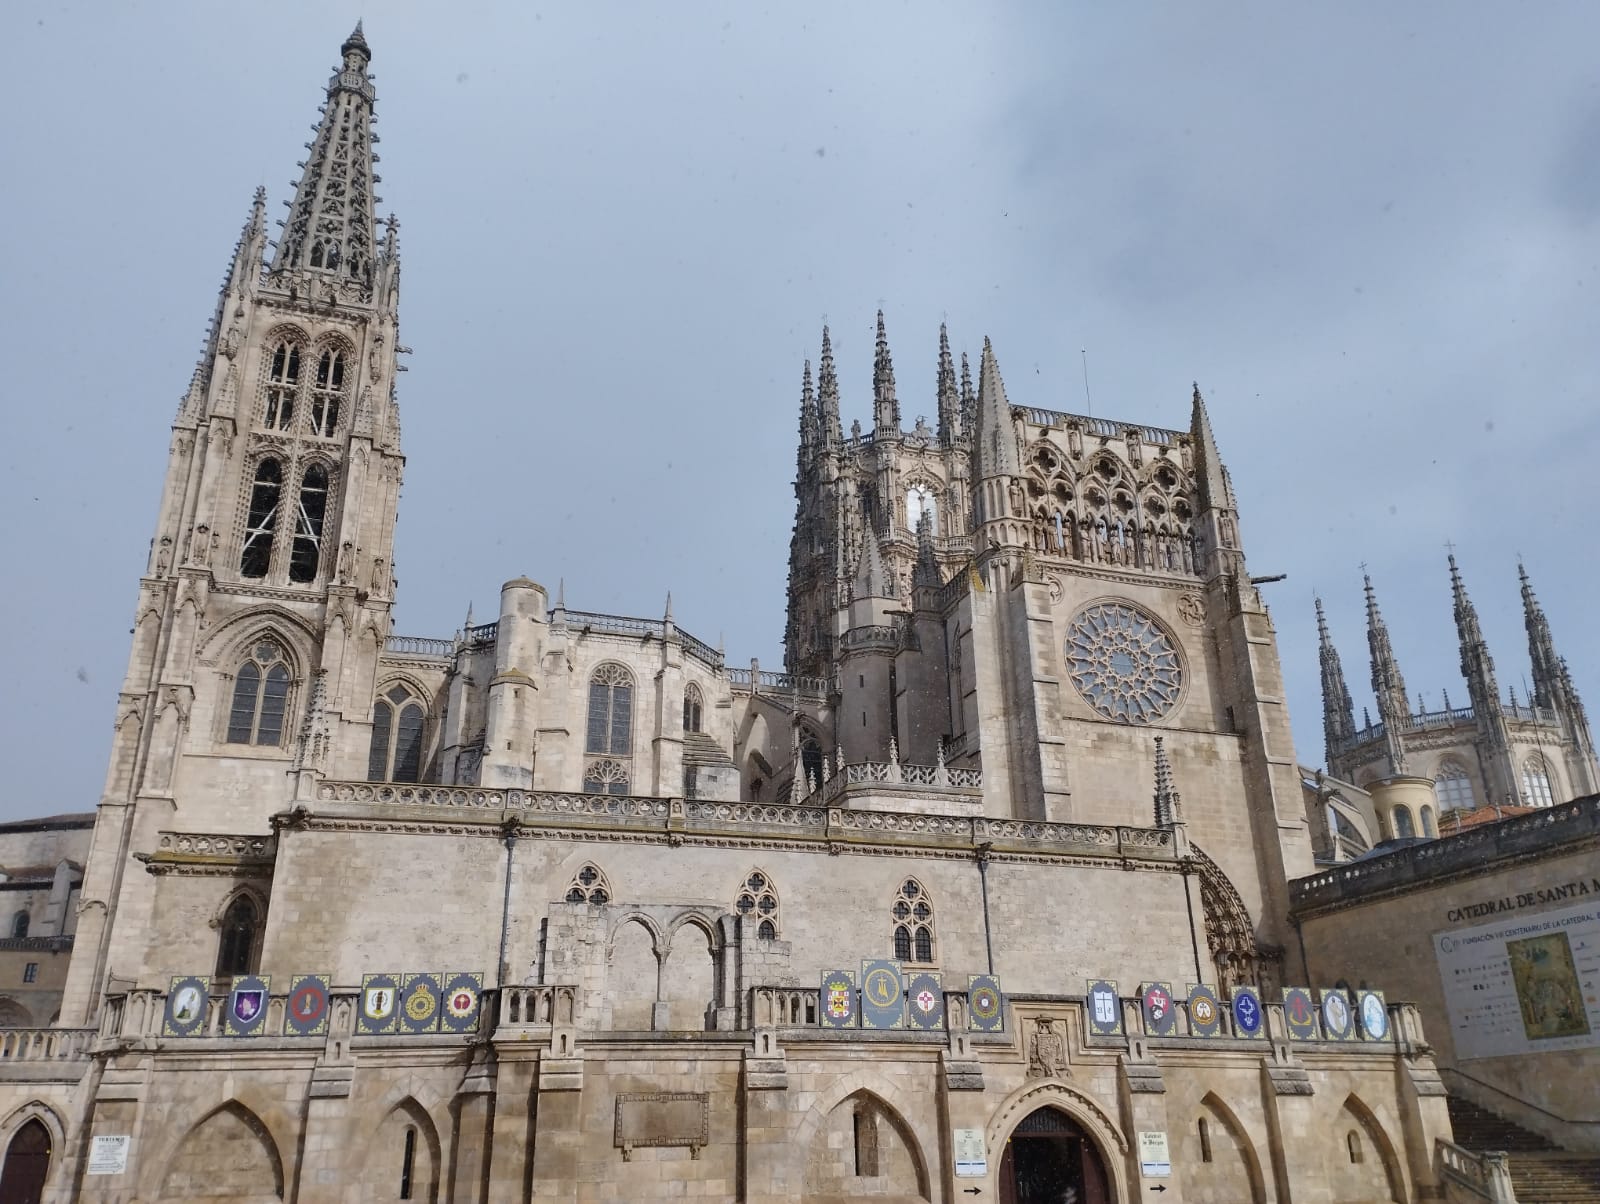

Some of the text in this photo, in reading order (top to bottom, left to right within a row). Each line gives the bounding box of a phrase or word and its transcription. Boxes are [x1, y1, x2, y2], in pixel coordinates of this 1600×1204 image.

[1447, 897, 1516, 922] CATEDRAL
[1516, 892, 1536, 908] DE
[1537, 881, 1590, 904] SANTA
[1543, 922, 1552, 930] DE
[1562, 914, 1594, 926] CATEDRAL
